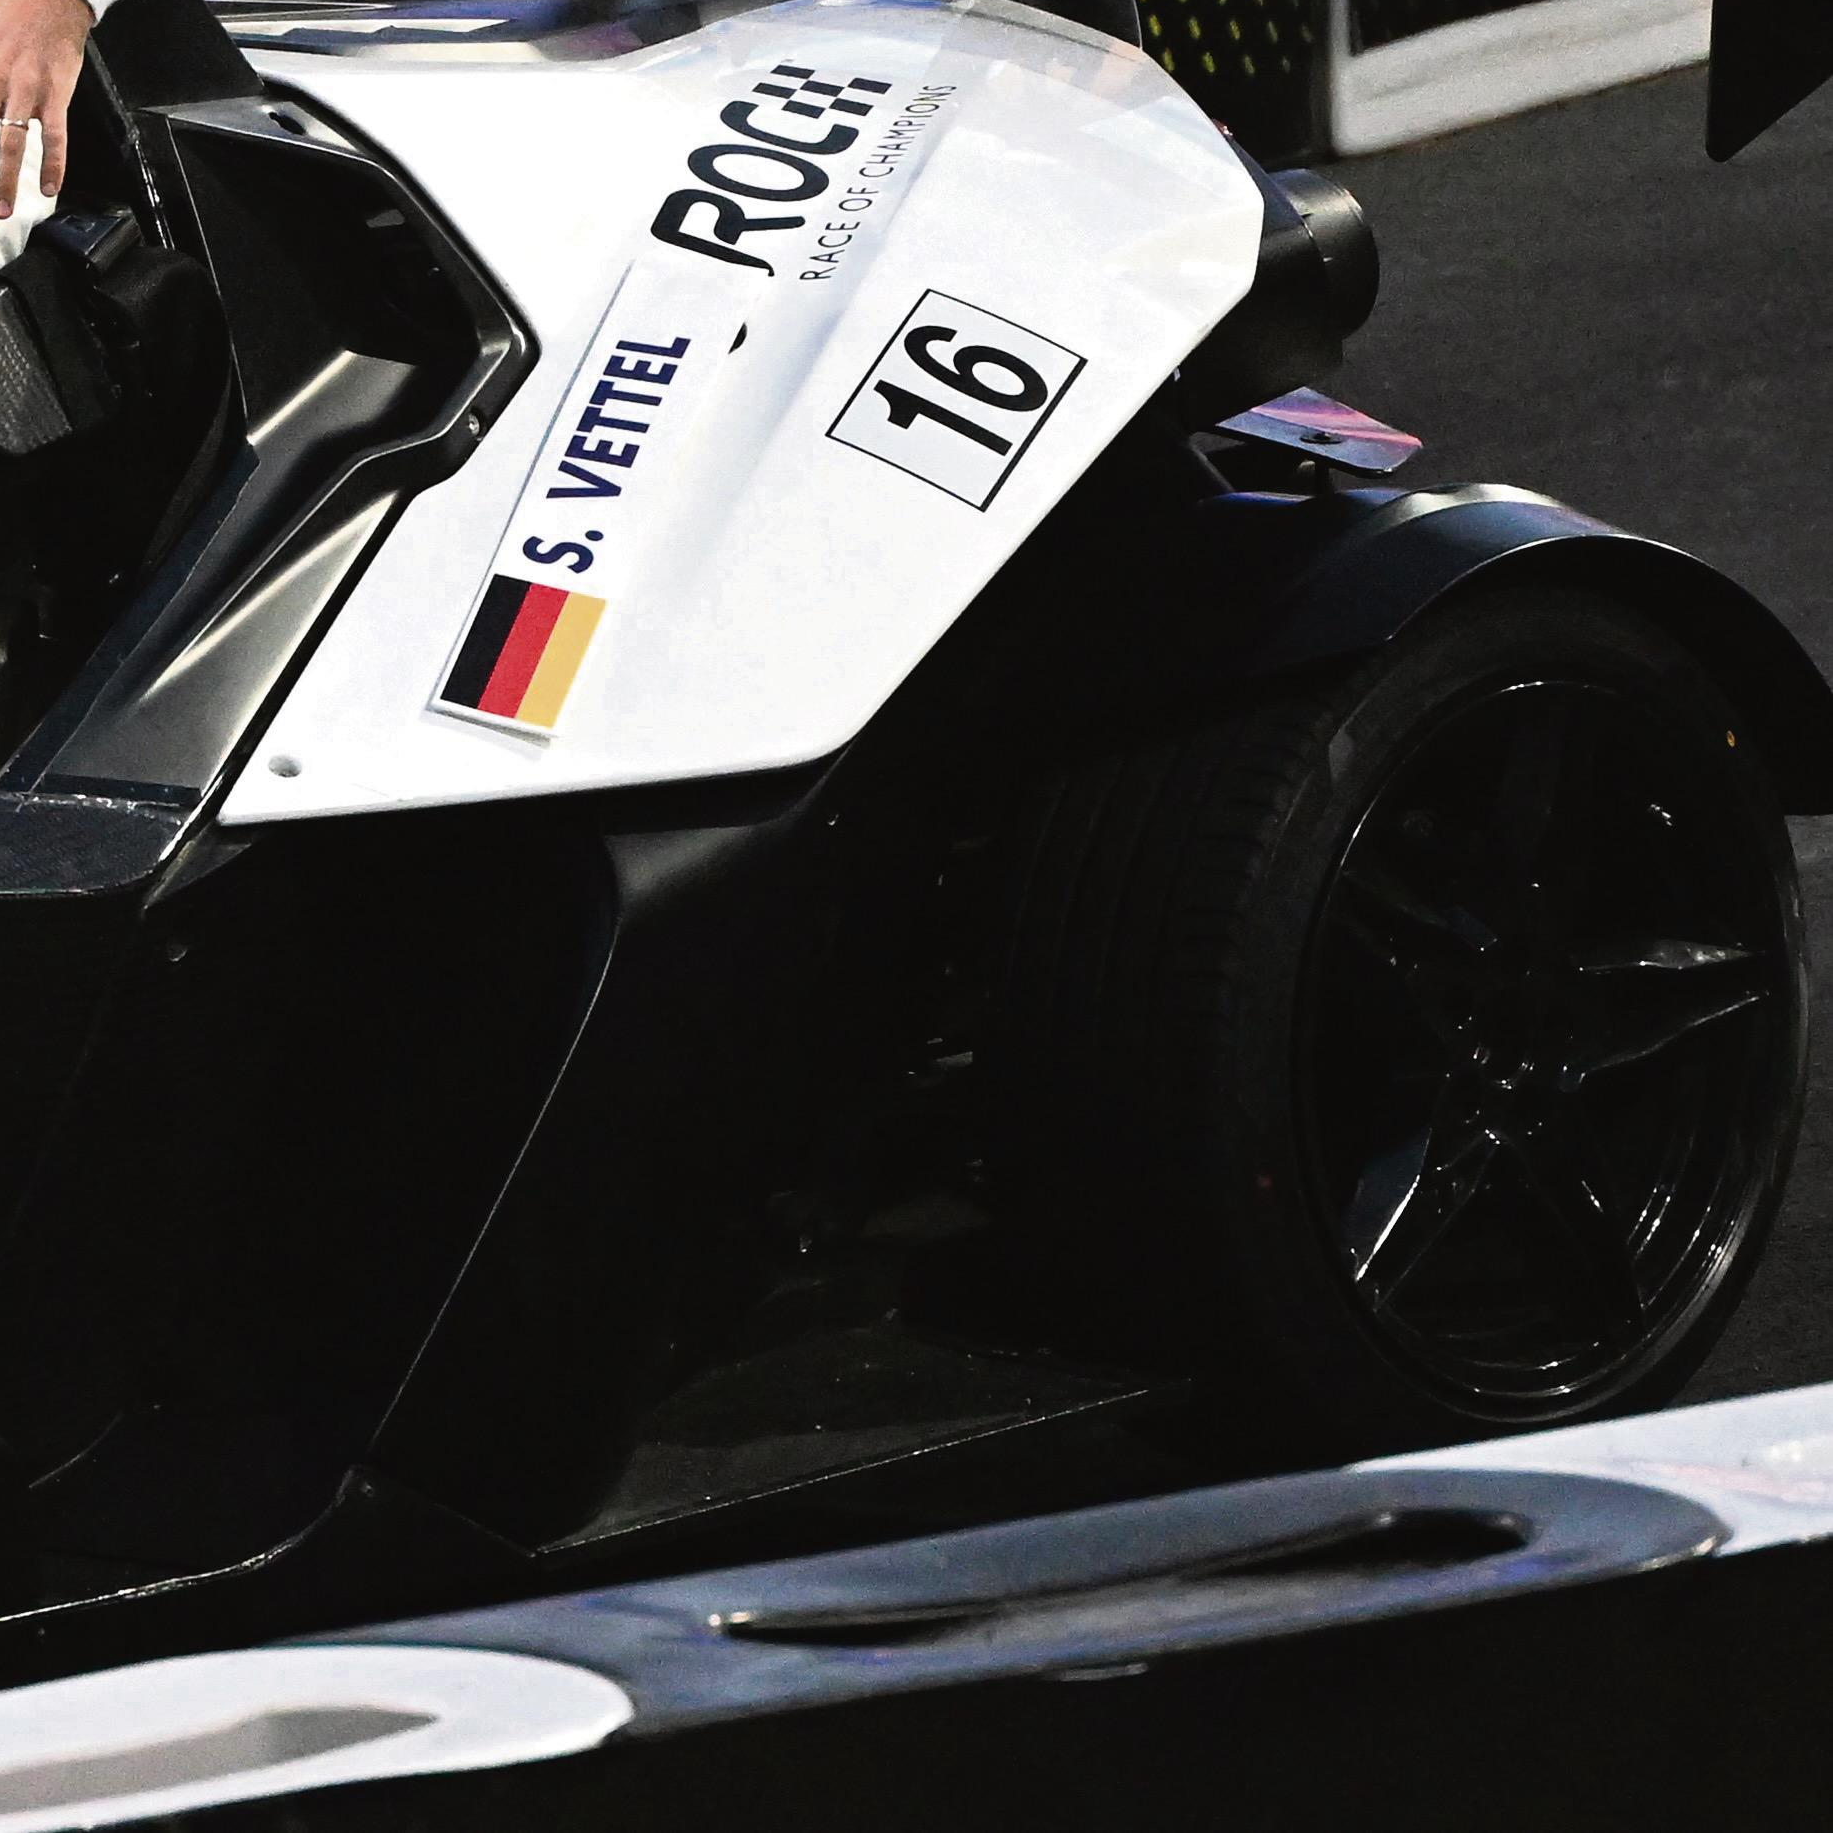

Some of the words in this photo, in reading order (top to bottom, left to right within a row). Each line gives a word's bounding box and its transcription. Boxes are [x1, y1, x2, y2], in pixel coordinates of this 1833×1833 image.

[858, 84, 958, 178] CHAMPIONS
[650, 100, 860, 278] ROC
[838, 187, 879, 212] OF
[799, 221, 861, 281] RACE
[547, 336, 688, 502] VETTEL
[873, 324, 1049, 456] 16
[523, 514, 604, 574] S.
